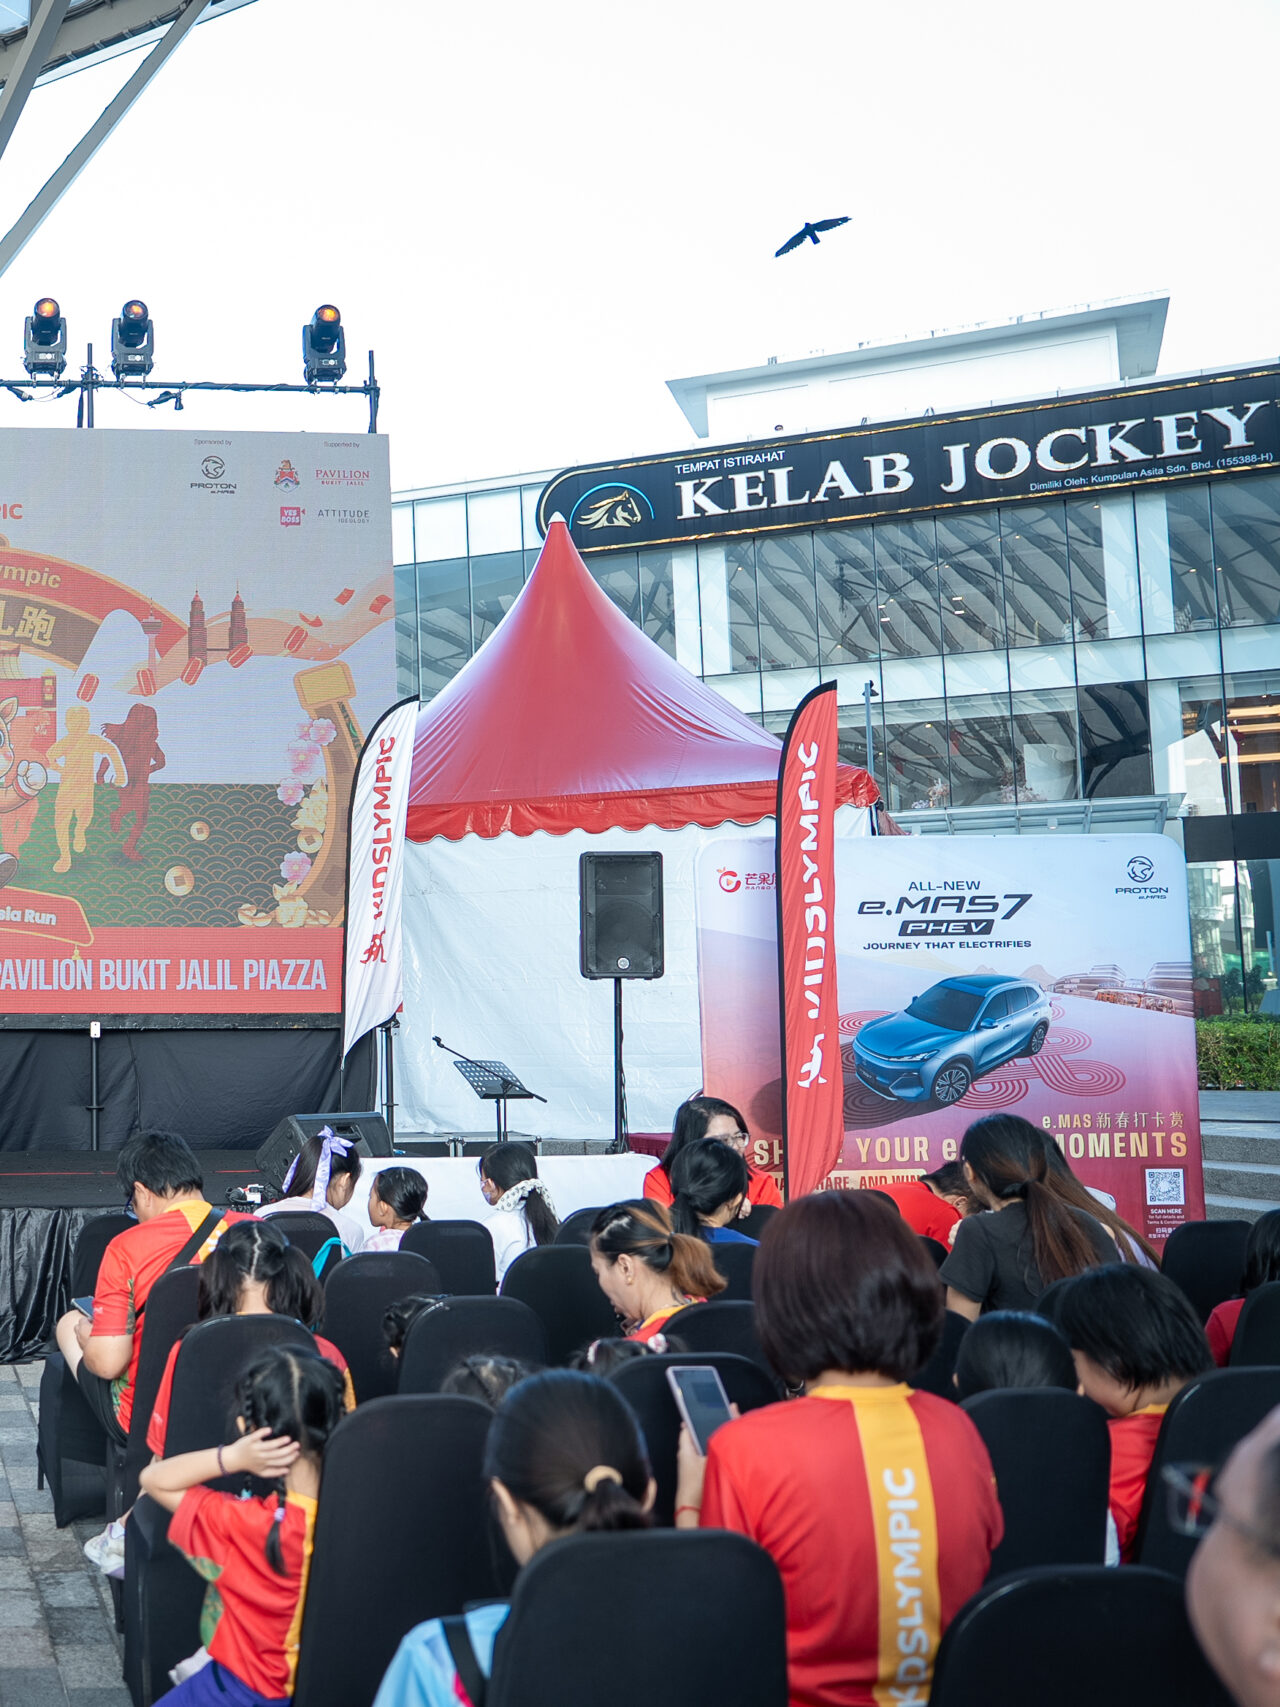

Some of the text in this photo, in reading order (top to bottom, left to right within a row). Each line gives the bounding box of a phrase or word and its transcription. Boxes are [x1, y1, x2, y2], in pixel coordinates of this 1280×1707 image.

[194, 438, 224, 446] Sponsored
[675, 400, 1270, 520] KELAB JOCKEY
[675, 450, 786, 475] TEMPAT ISTIRAHAT
[315, 469, 370, 478] PAVILION
[1029, 451, 1273, 492] Dimiliki Oleh: Kumpulan Asita Sdn. Bhd. (155388-H)
[317, 509, 370, 518] ATTITUDE
[908, 880, 981, 891] ALL-NEW
[24, 909, 57, 926] Run
[905, 921, 989, 934] PHEV
[863, 940, 1032, 950] JOURNEY THAT ELECTRIFIES
[99, 959, 171, 990] BUKIT
[176, 959, 238, 990] JALIL
[243, 959, 327, 990] PIAZZA
[1042, 1111, 1184, 1129] e.MAS 新春打卡赏
[855, 1136, 929, 1163] YOUR
